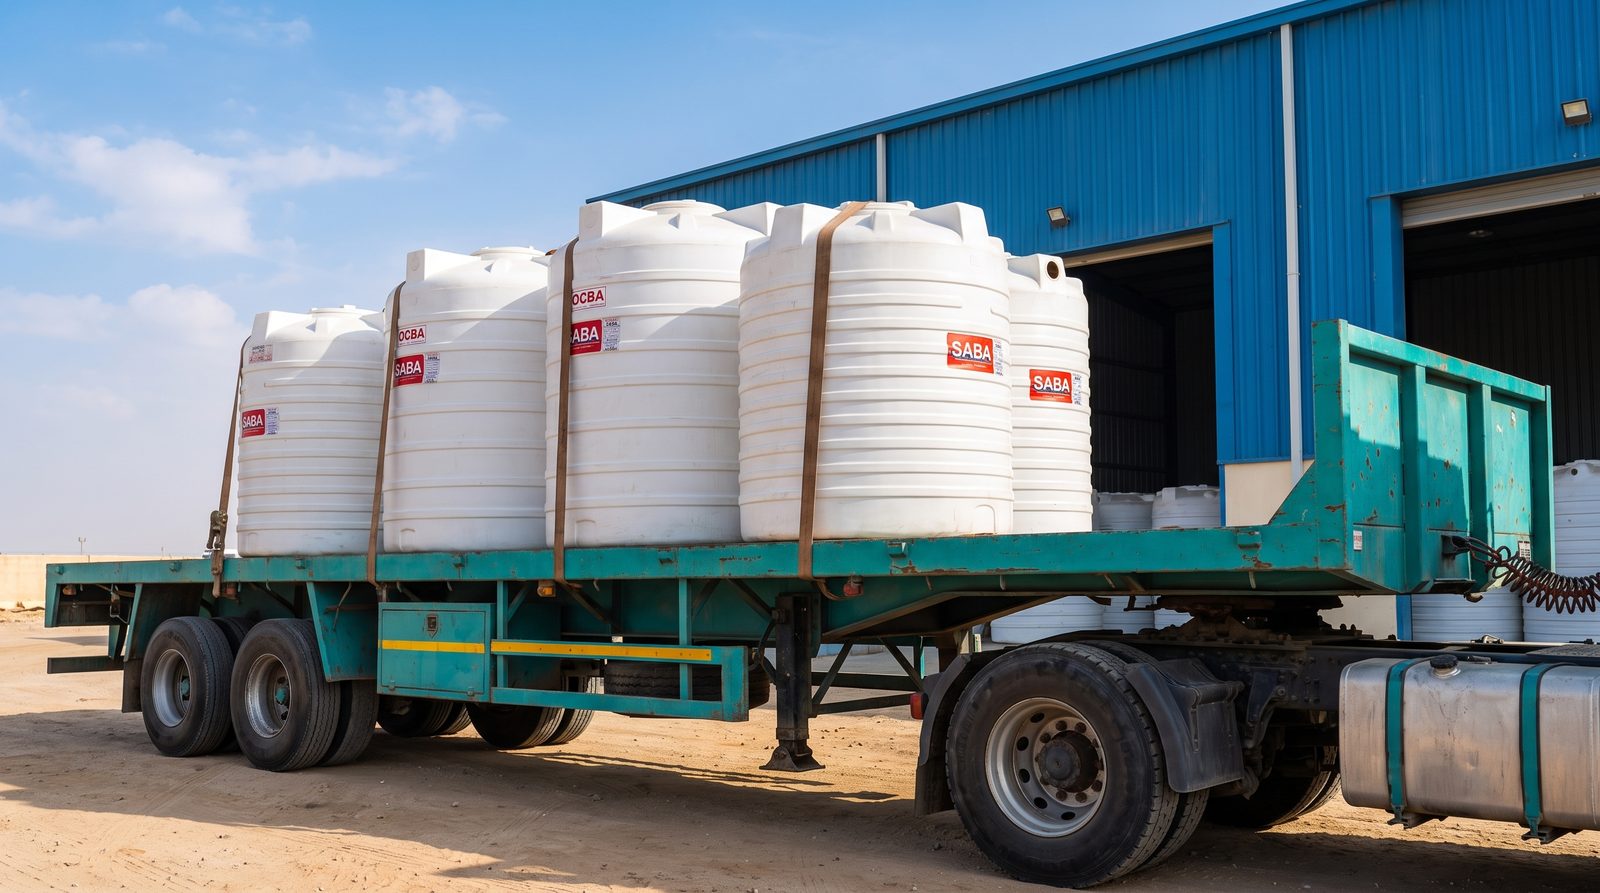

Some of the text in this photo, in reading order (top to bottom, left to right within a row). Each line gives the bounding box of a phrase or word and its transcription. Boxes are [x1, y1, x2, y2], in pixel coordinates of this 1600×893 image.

[399, 328, 424, 342] OCBA
[570, 326, 599, 344] ABA
[952, 341, 991, 362] SABA
[395, 361, 421, 378] SABA
[1034, 376, 1070, 394] SABA
[242, 414, 263, 428] SABA
